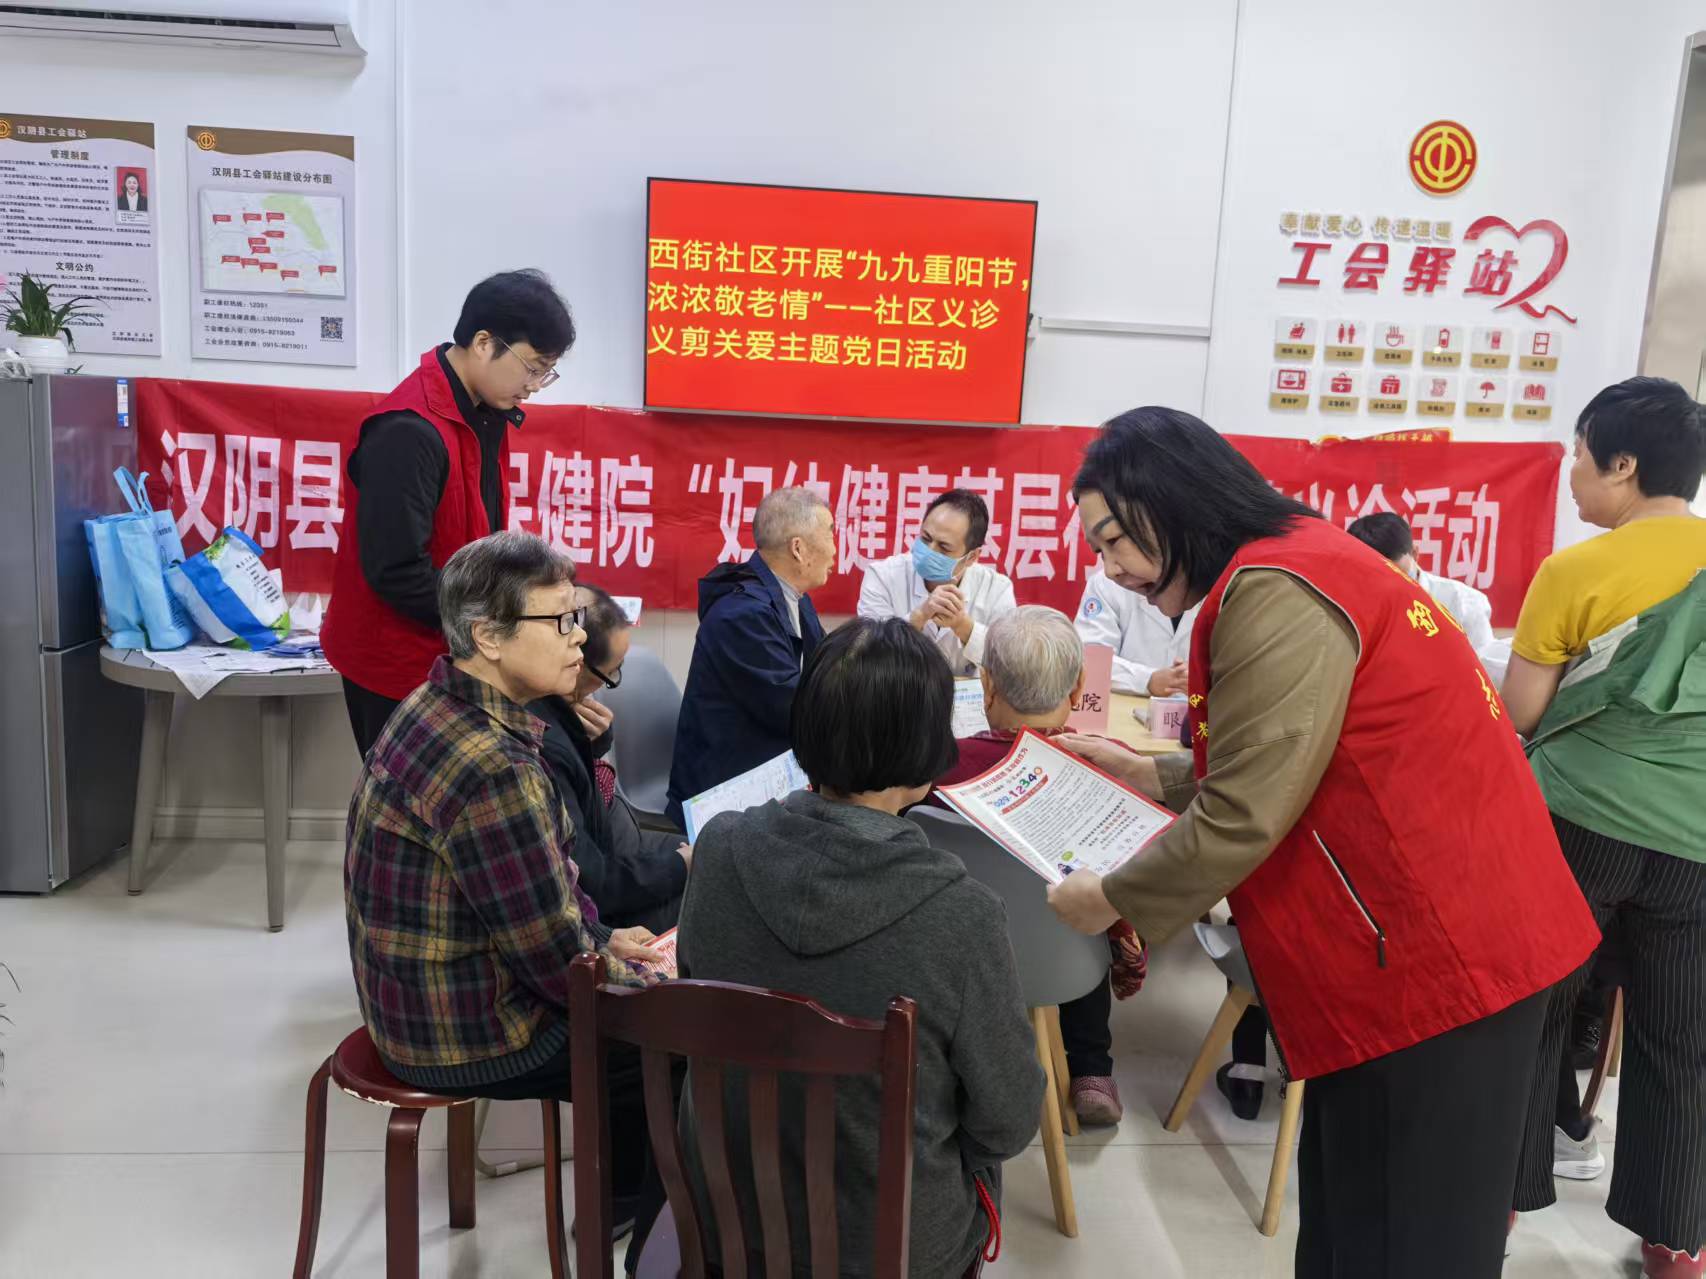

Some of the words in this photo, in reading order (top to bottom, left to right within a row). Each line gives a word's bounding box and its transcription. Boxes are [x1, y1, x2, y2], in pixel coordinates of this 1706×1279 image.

[211, 166, 333, 185] 汉阴县工会驿站建设分布图
[55, 261, 95, 273] 文明公约
[1278, 242, 1519, 296] 工会驿站
[647, 325, 968, 371] 义剪关爱主题党日活动
